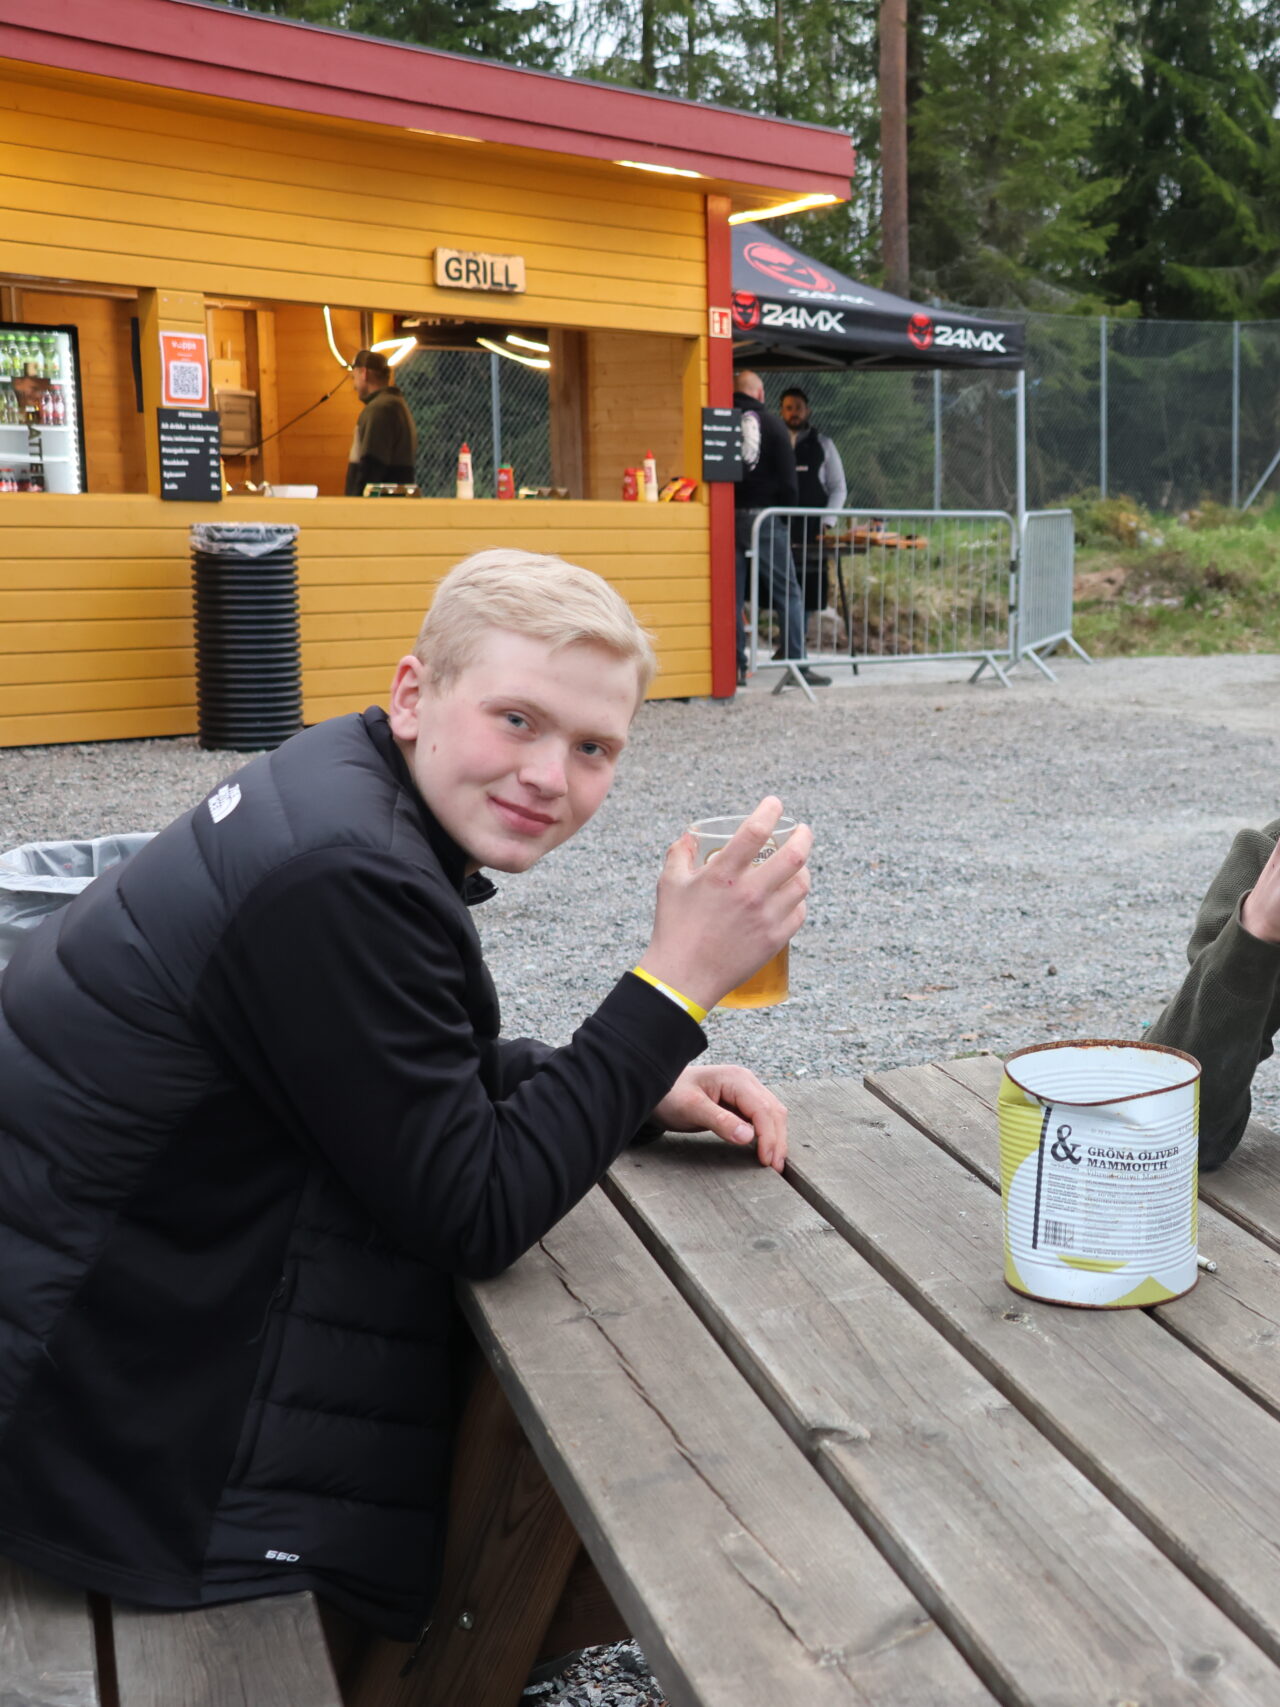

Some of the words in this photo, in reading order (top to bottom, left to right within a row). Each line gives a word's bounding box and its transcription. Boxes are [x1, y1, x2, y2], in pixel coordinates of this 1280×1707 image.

[445, 257, 518, 288] GRILL
[761, 303, 846, 334] 24MX
[934, 325, 1007, 354] 24MX
[1050, 1124, 1082, 1165] &
[1087, 1146, 1134, 1161] GRÖNA
[1138, 1146, 1179, 1161] OLIVER
[1087, 1157, 1168, 1172] MAMMOUTH
